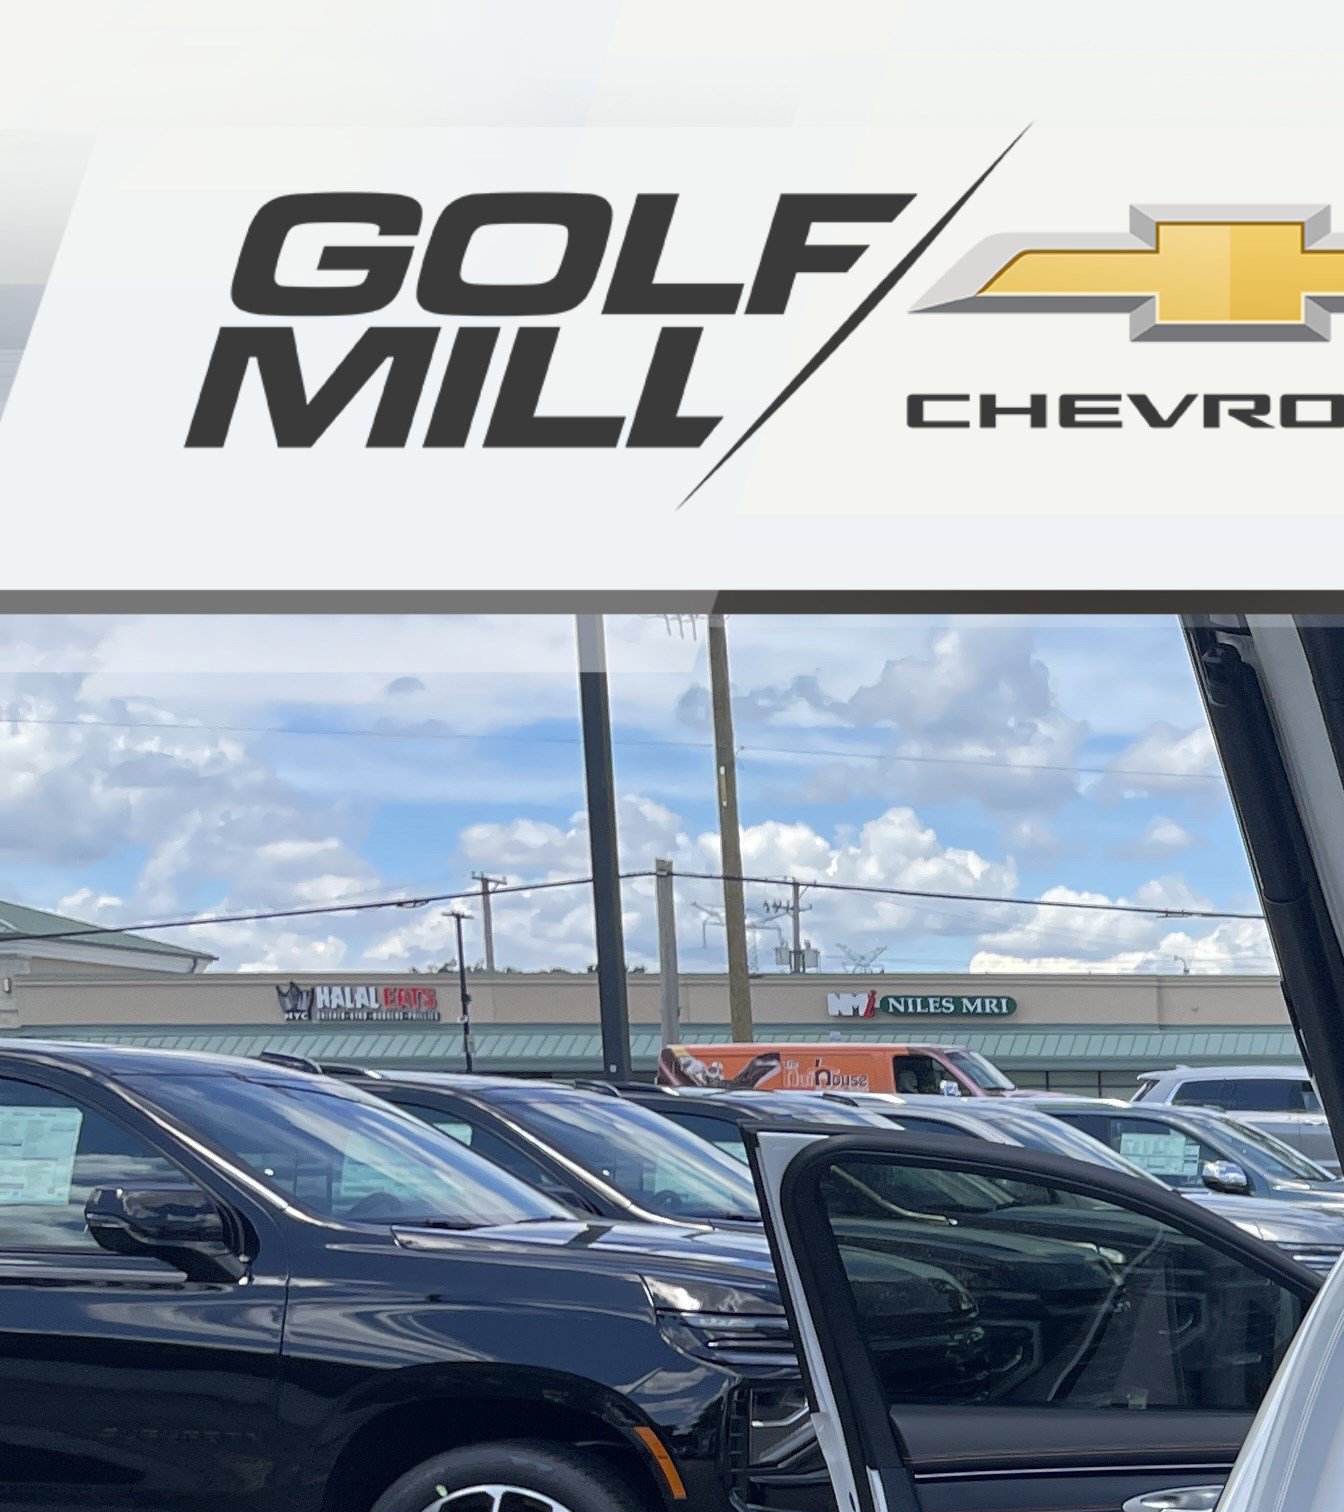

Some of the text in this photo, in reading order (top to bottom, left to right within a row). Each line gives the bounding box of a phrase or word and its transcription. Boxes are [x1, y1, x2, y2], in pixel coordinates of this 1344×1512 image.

[316, 986, 437, 1010] HALAL EATS
[888, 997, 1009, 1014] NILES MRI
